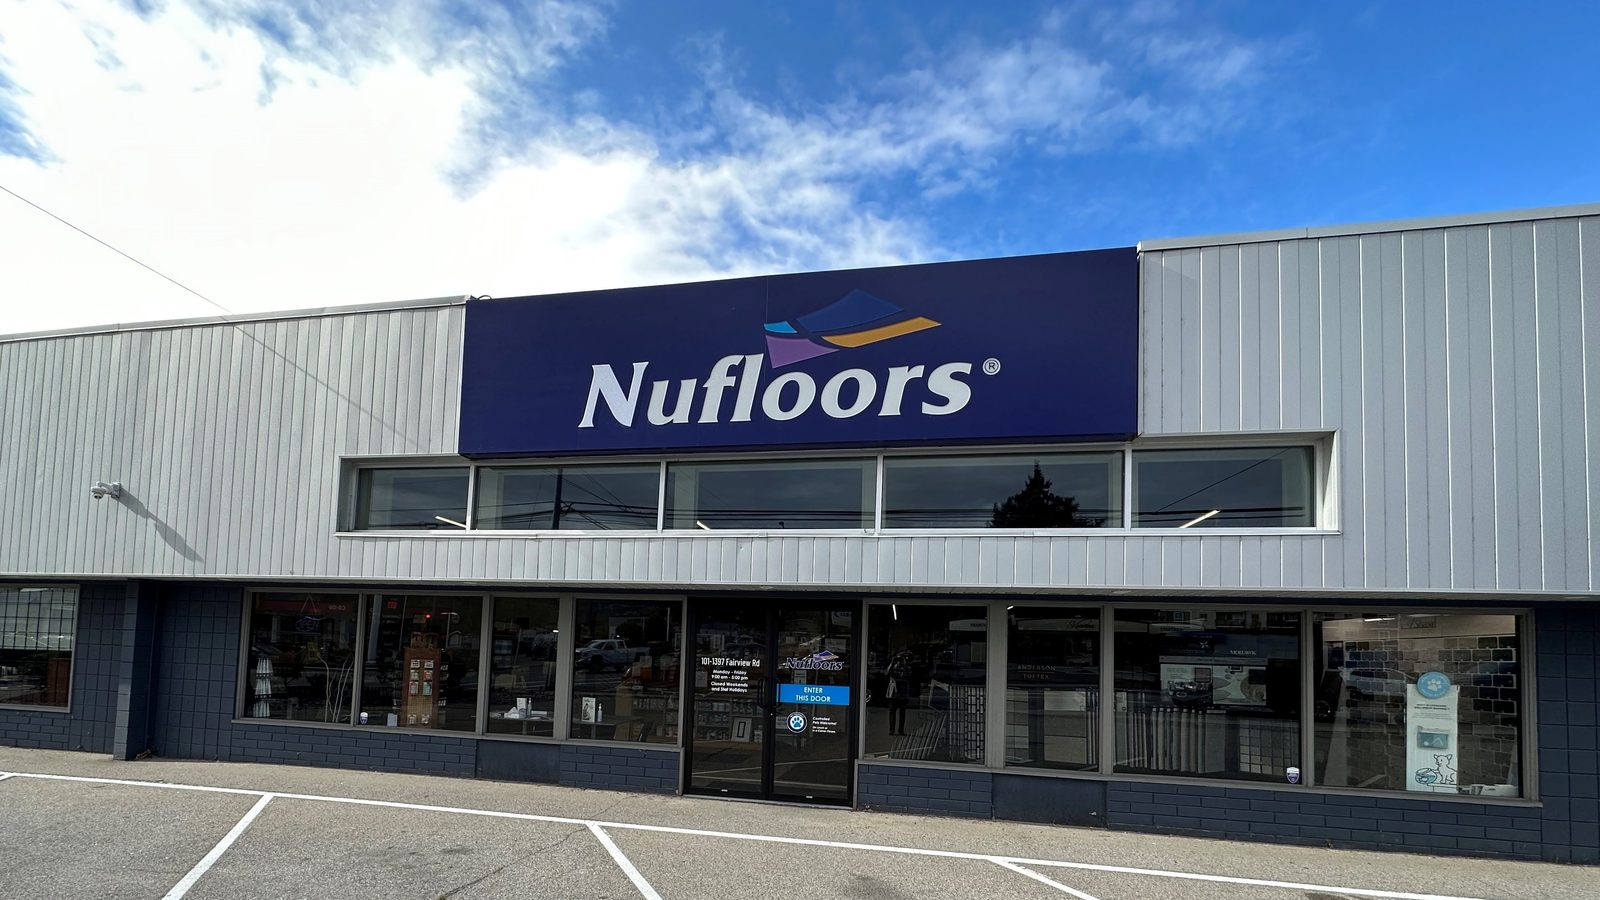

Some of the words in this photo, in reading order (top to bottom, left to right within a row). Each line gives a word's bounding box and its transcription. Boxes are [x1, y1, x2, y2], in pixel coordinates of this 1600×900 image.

[578, 353, 972, 428] Nufloors
[701, 657, 725, 666] 101-1397
[726, 658, 751, 667] Fairview
[752, 659, 761, 667] Rd
[785, 657, 843, 671] Nufloors
